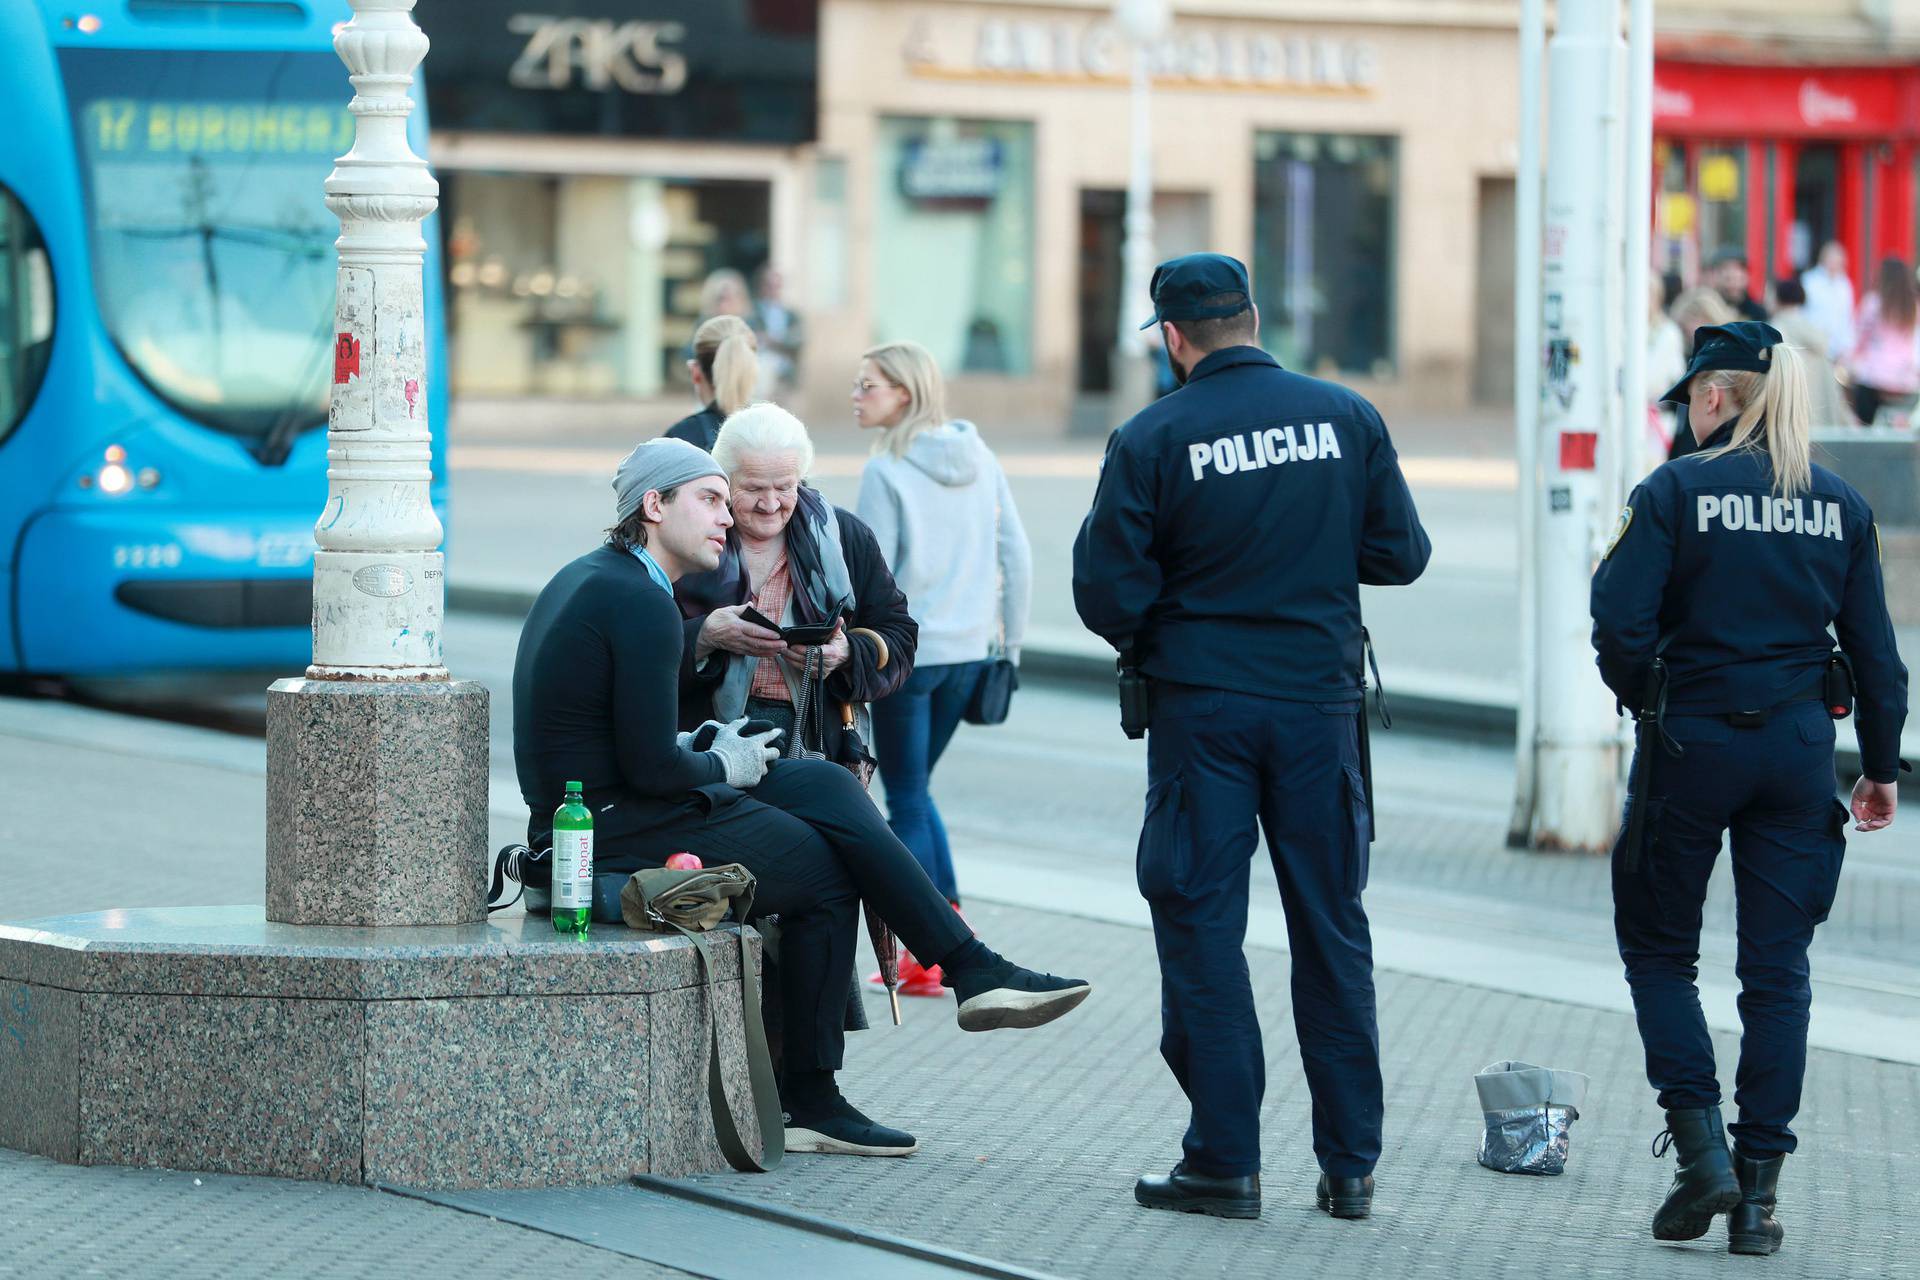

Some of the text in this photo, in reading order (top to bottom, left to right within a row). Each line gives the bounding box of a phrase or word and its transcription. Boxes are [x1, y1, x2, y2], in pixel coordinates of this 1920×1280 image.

[507, 14, 686, 94] ZAKS
[1188, 422, 1342, 481] POLICIJA
[1697, 494, 1843, 541] POLICIJA
[578, 836, 588, 878] Donat
